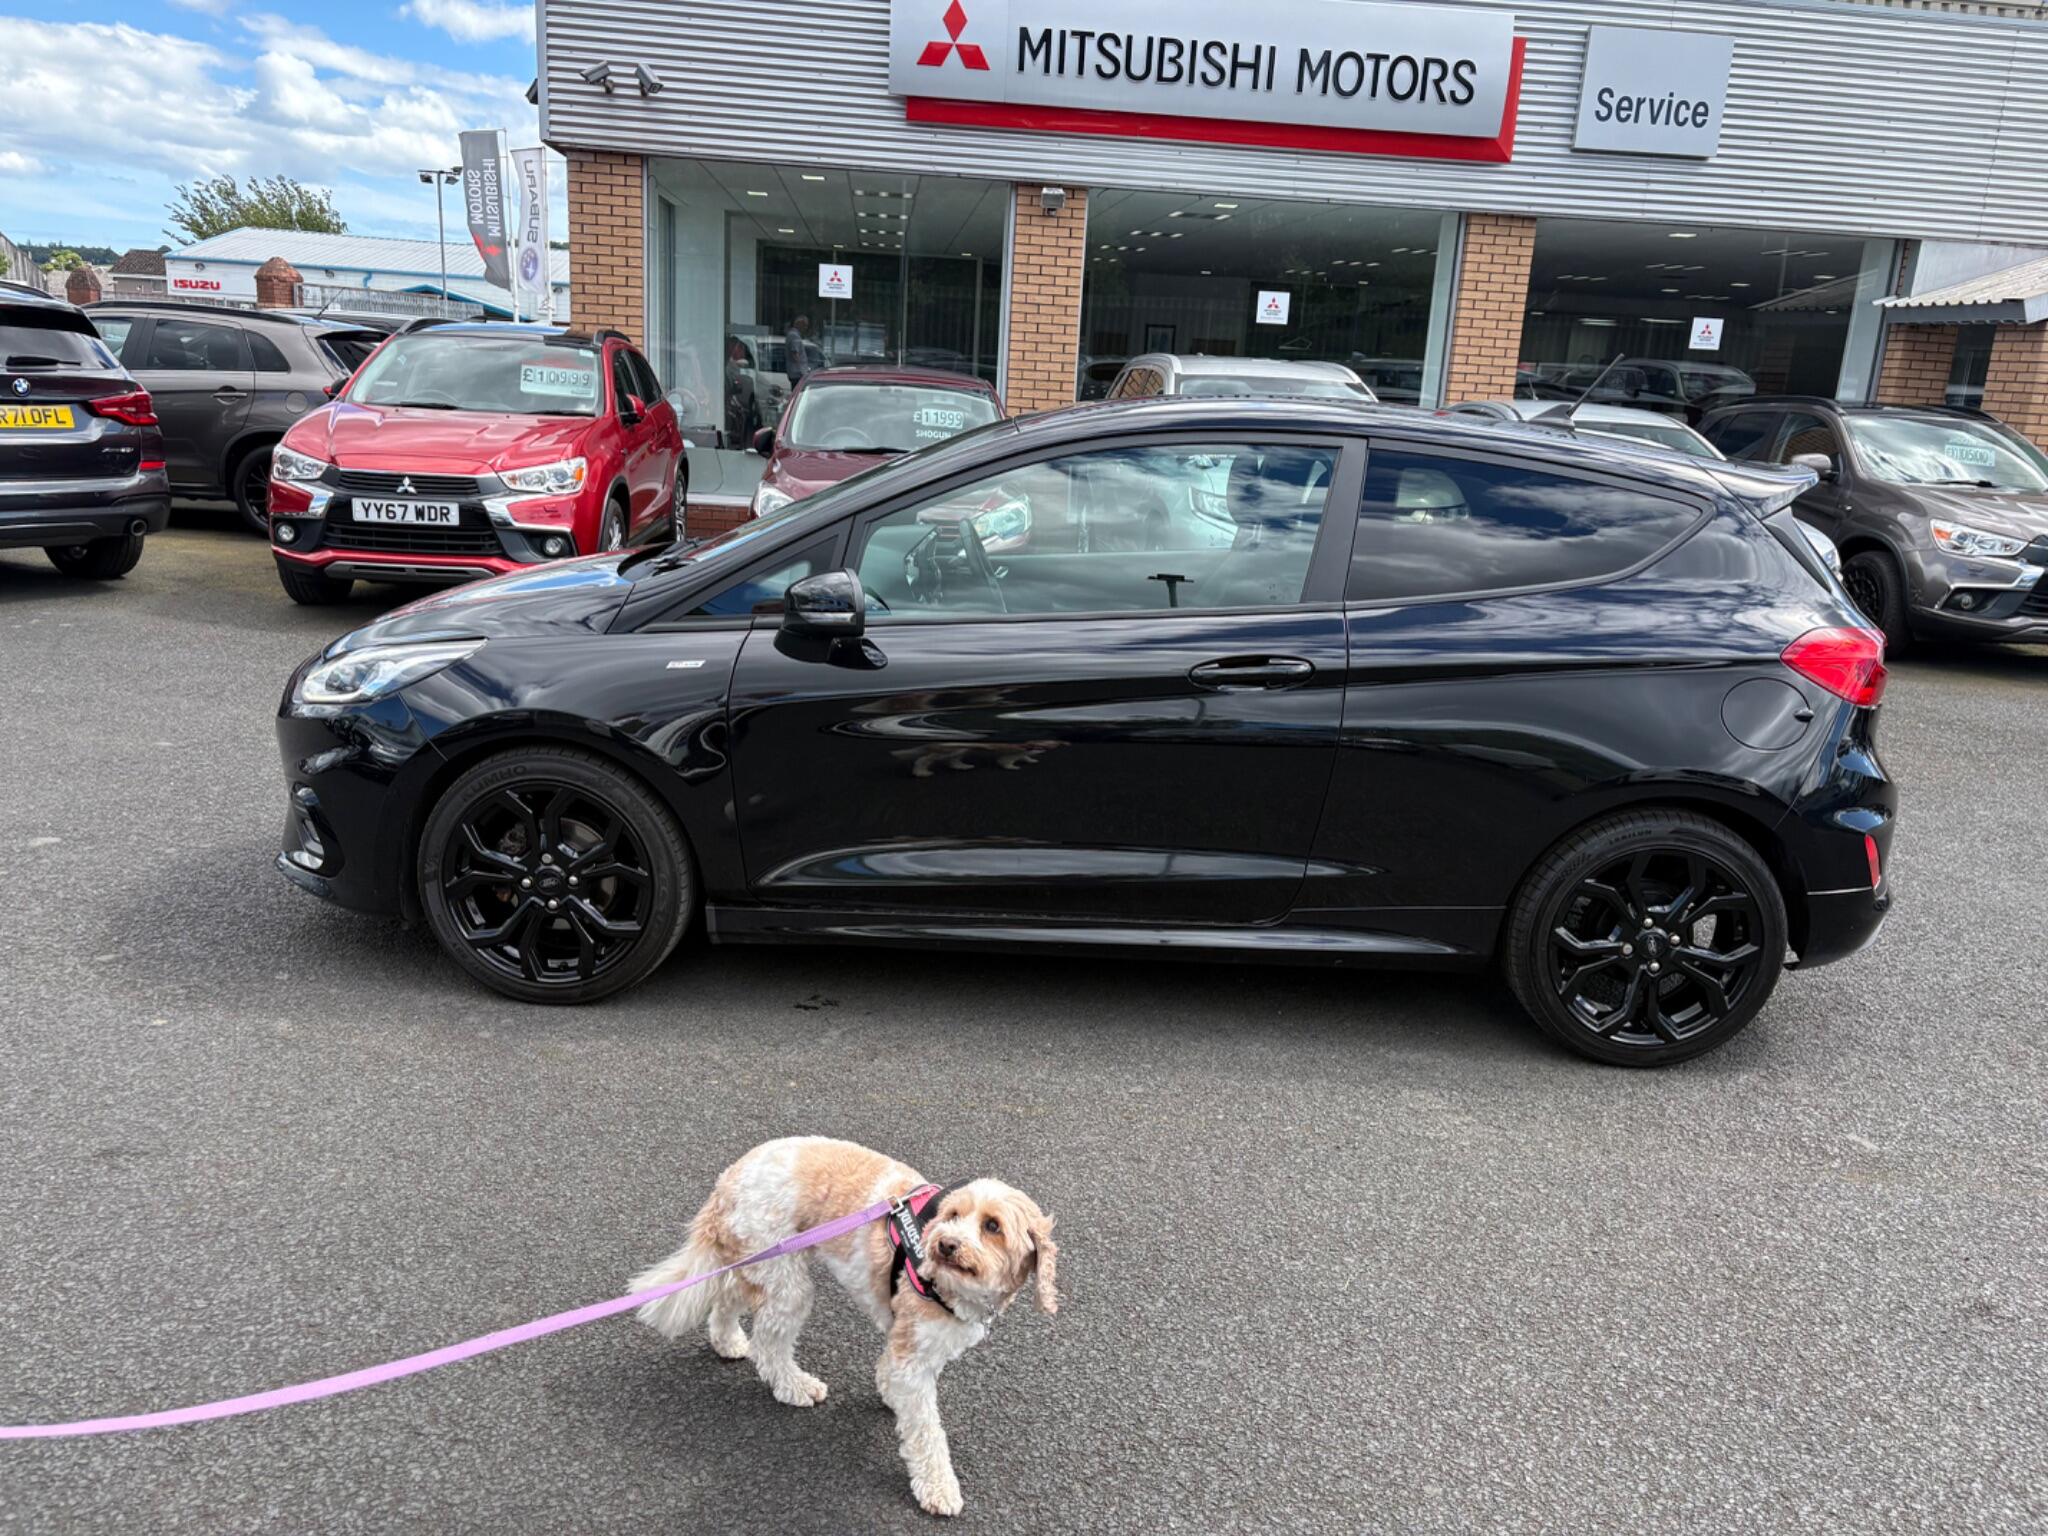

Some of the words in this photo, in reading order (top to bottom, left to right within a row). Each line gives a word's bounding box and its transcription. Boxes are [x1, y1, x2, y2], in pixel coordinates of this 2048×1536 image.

[1016, 26, 1276, 92] MITSUBISHI
[1296, 47, 1478, 105] MOTORS
[1594, 87, 1709, 129] Service
[174, 279, 220, 290] ISUZU
[522, 368, 590, 387] £10999
[361, 502, 408, 521] YY67
[414, 504, 451, 523] WDR
